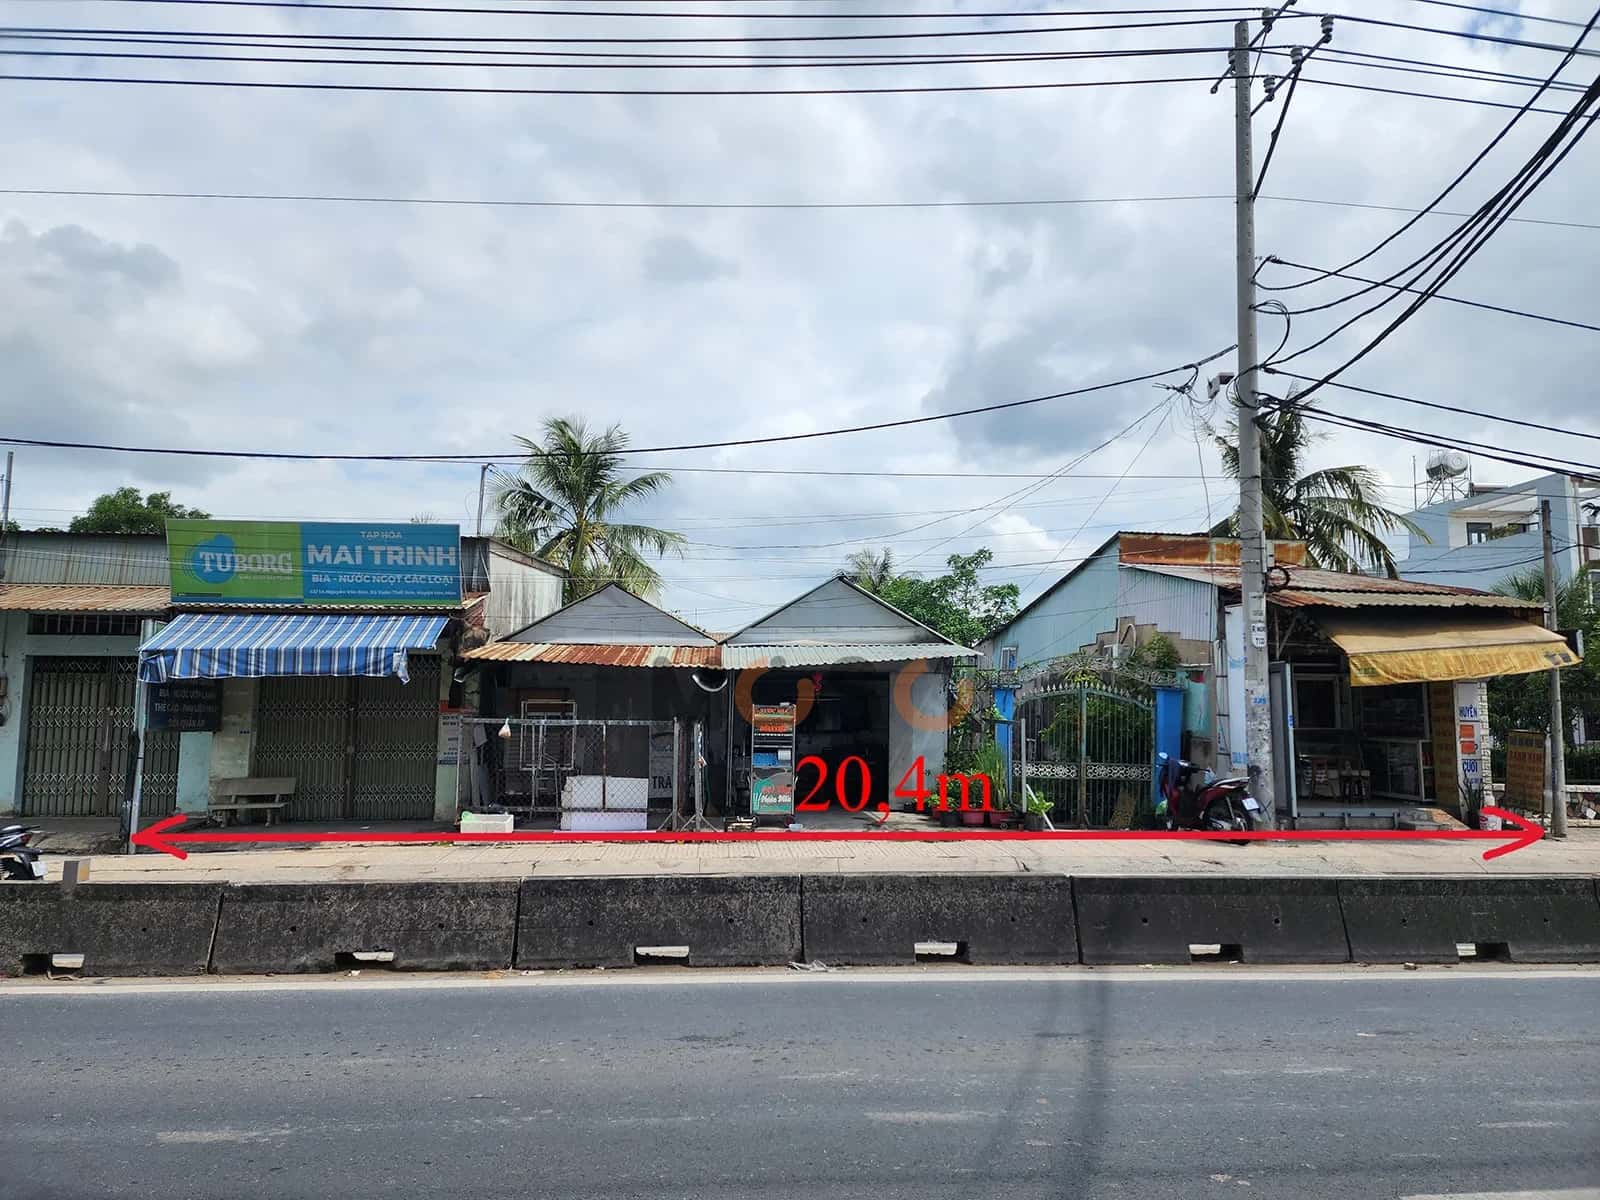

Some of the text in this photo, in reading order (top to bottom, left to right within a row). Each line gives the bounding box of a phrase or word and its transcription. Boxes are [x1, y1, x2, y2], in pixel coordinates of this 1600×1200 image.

[199, 552, 293, 576] TUBORG
[307, 544, 456, 567] MAI TRINH
